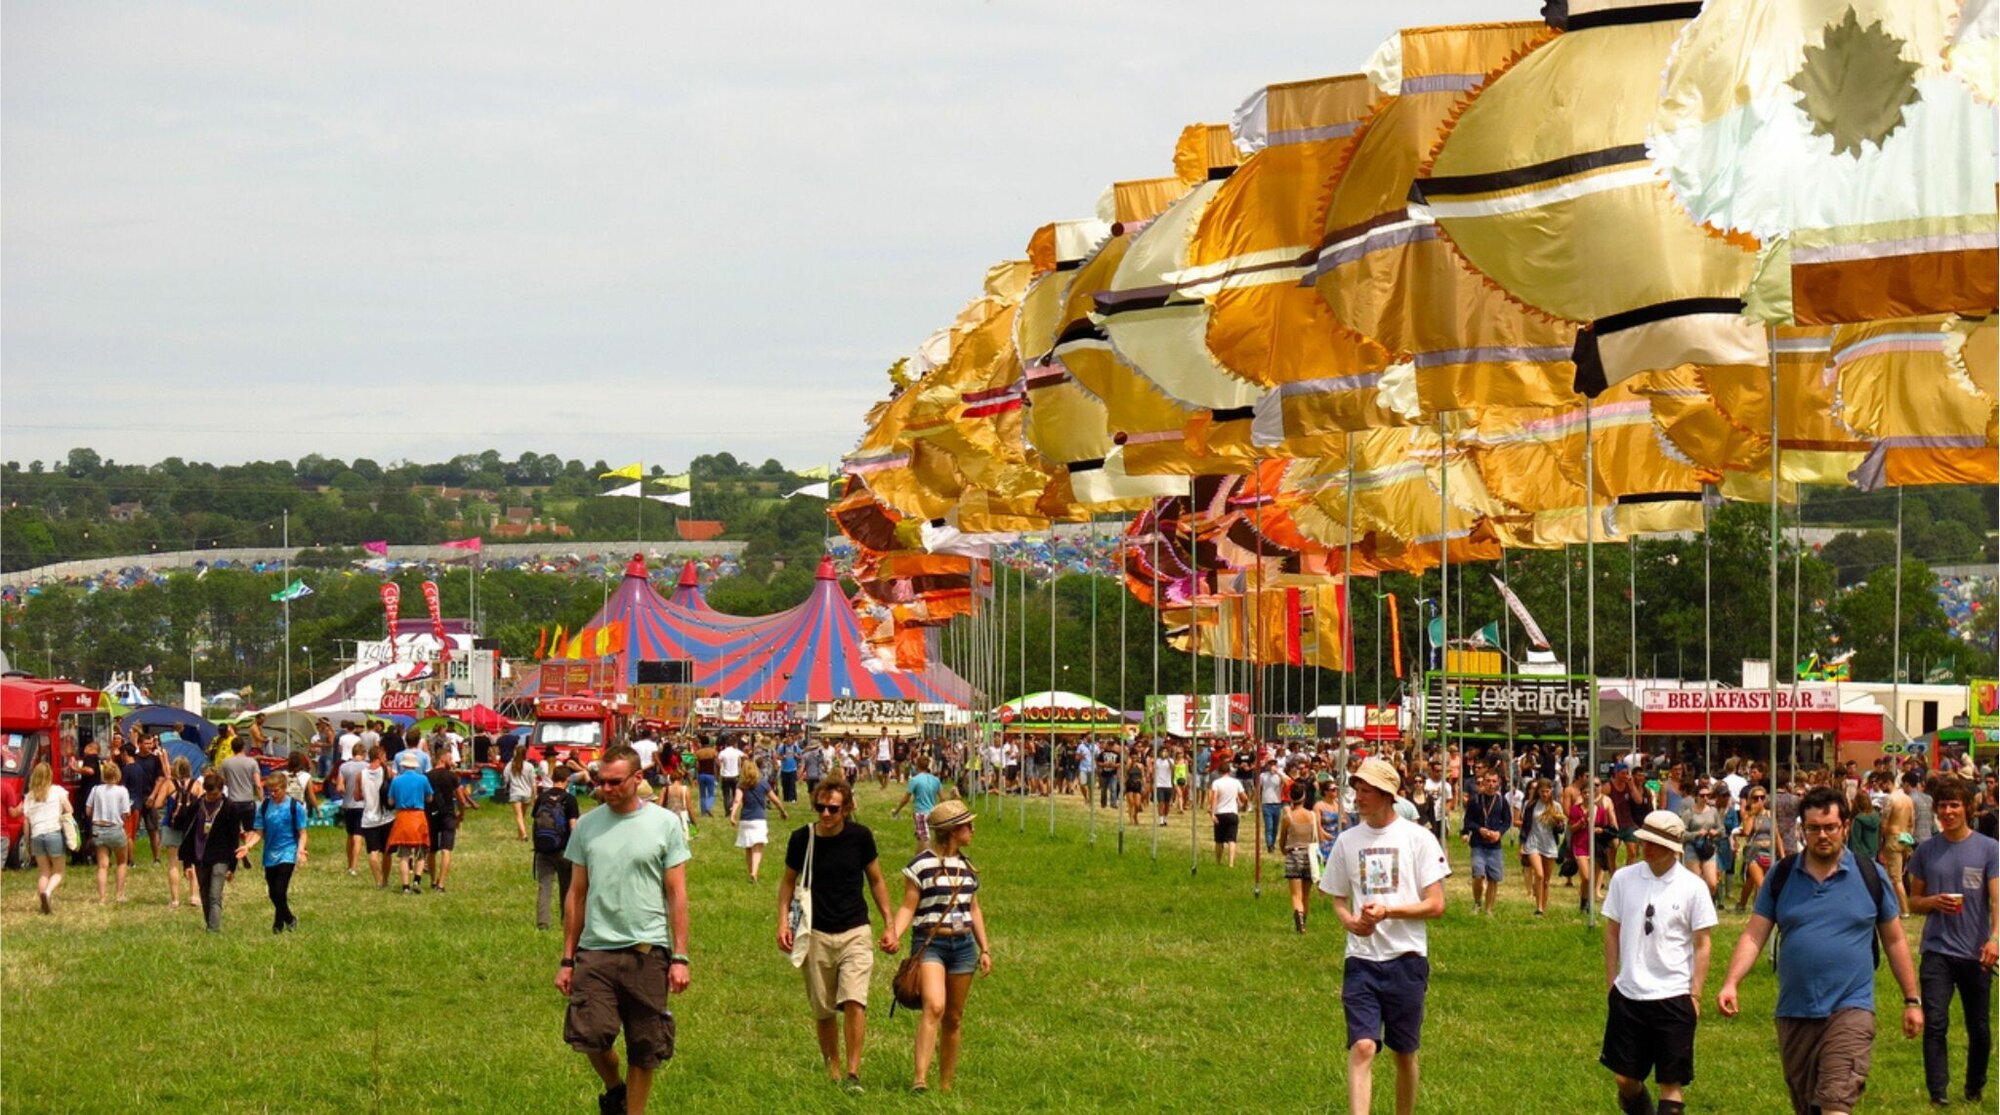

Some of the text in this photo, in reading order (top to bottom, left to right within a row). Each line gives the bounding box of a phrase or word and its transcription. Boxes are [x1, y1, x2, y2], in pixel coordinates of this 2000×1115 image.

[1668, 692, 1812, 708] BREAKFAST BAR
[545, 703, 595, 711] ICE CREAM
